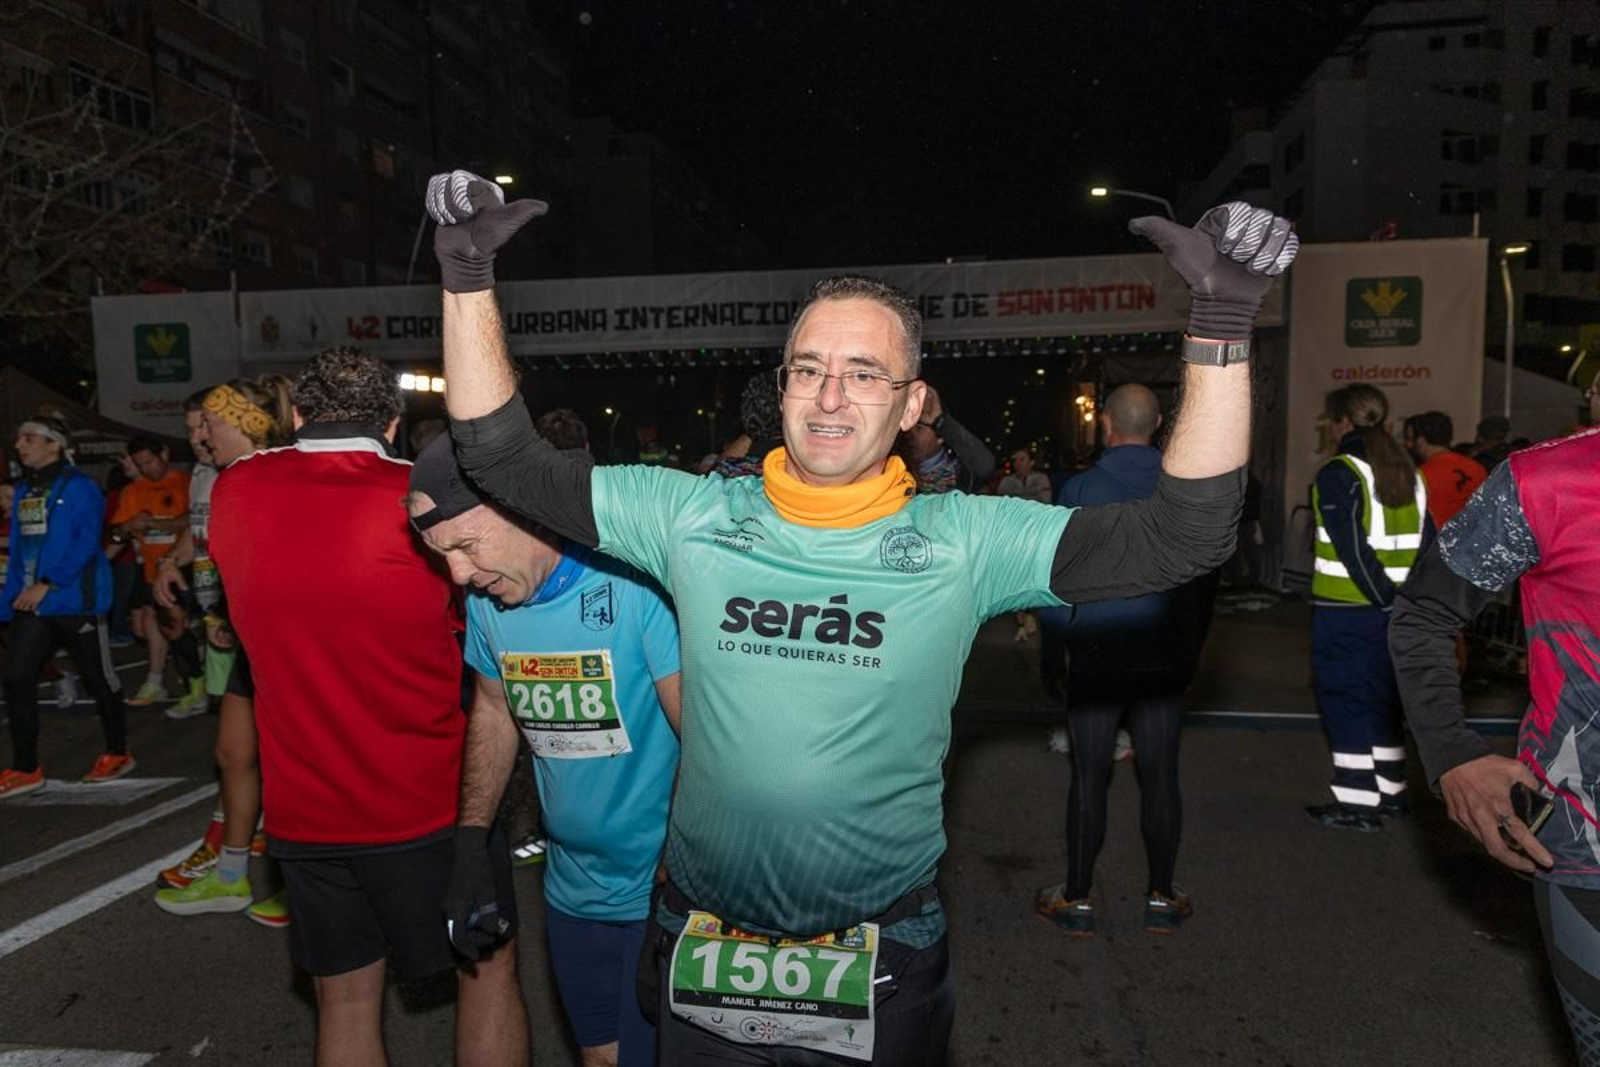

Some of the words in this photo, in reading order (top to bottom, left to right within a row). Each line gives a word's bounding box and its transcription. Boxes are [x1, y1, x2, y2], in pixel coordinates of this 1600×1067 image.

[346, 315, 382, 340] 42
[508, 309, 607, 334] URBANA
[952, 292, 989, 318] DE
[997, 288, 1054, 318] SAN
[1058, 282, 1155, 314] ANTON
[1331, 363, 1430, 380] calderón
[719, 594, 886, 649] serás
[520, 658, 539, 677] 42
[717, 640, 735, 652] LO
[741, 642, 772, 656] QUE
[777, 647, 846, 664] QUIERAS
[852, 655, 882, 669] SER
[511, 683, 606, 720] 2618
[692, 940, 858, 999] 1567
[721, 995, 756, 1008] MANUEL
[759, 998, 792, 1010] JIMENEZ
[795, 1001, 819, 1012] CANO
